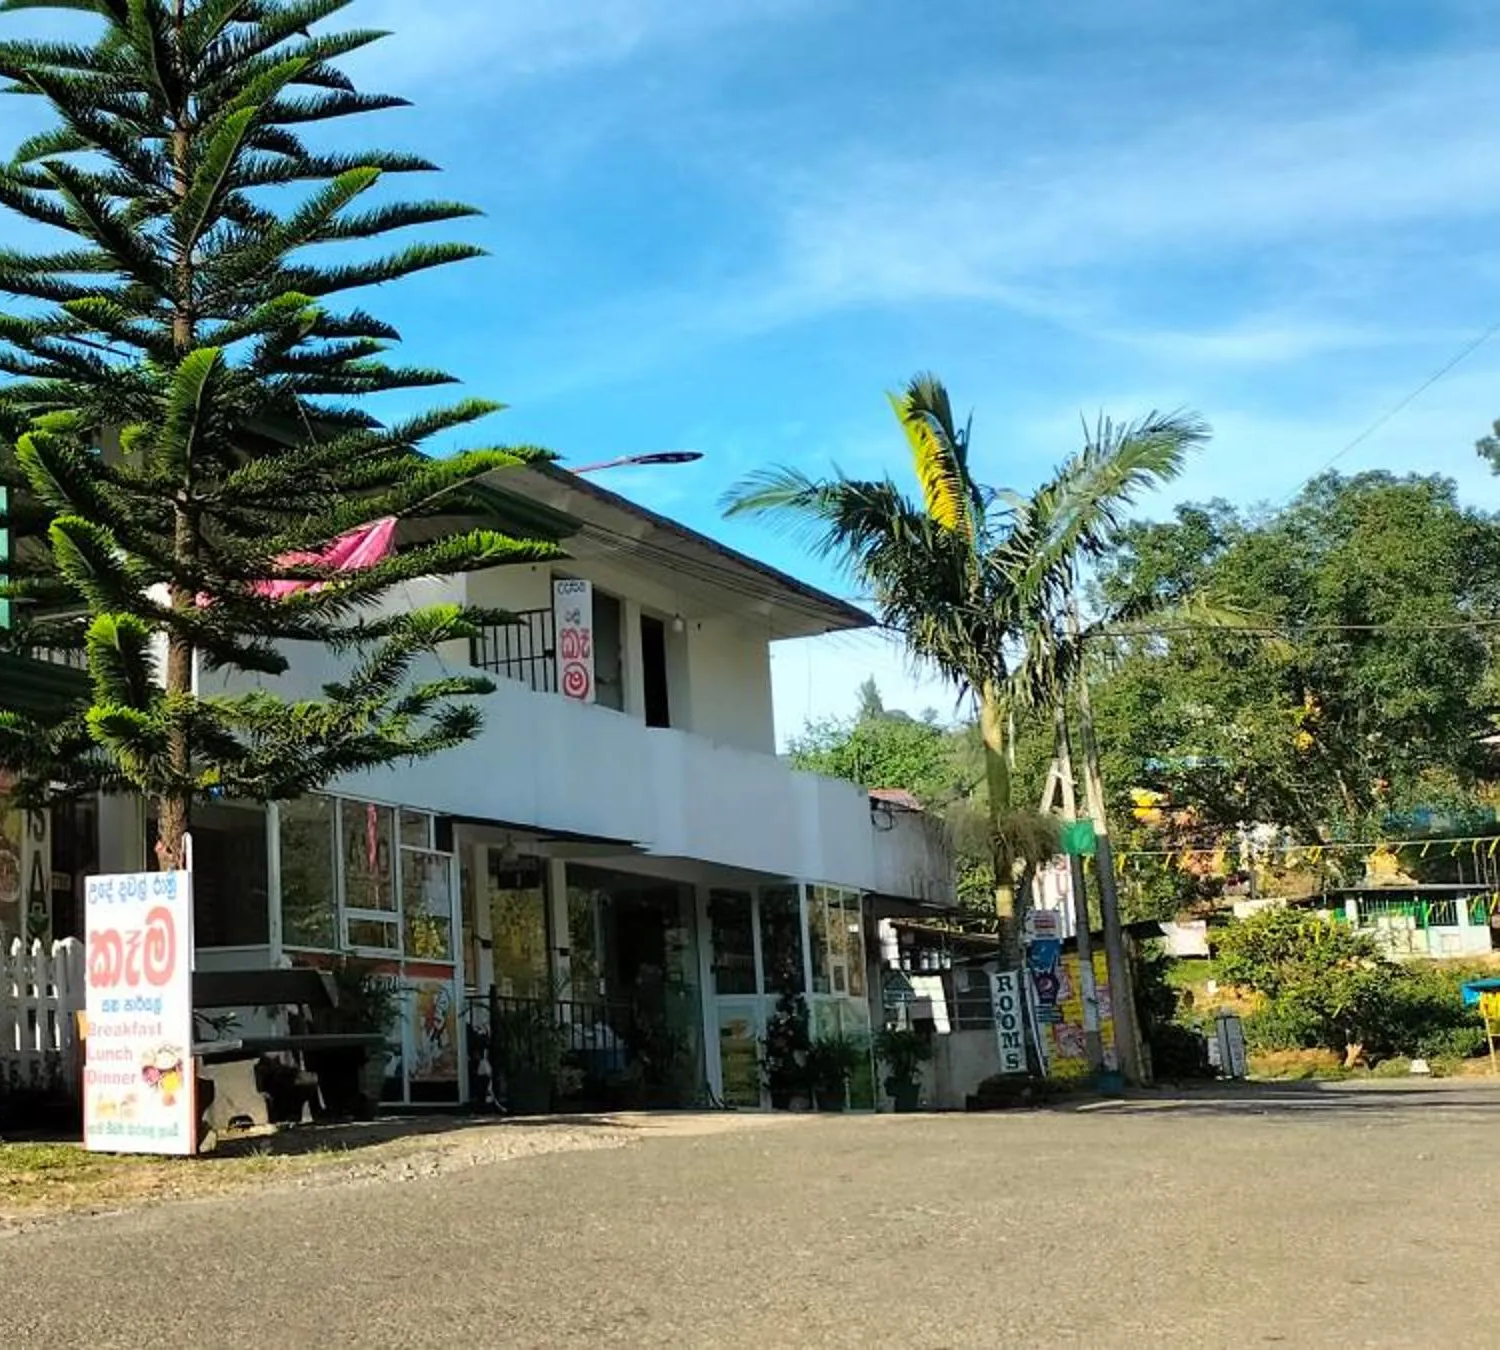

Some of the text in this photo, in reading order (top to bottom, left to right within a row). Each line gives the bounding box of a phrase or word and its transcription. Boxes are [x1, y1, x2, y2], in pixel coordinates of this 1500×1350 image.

[87, 1021, 163, 1037] Breakfast
[996, 975, 1020, 1070] ROOMS
[87, 1045, 133, 1061] Lunch
[86, 1069, 137, 1085] Dinner
